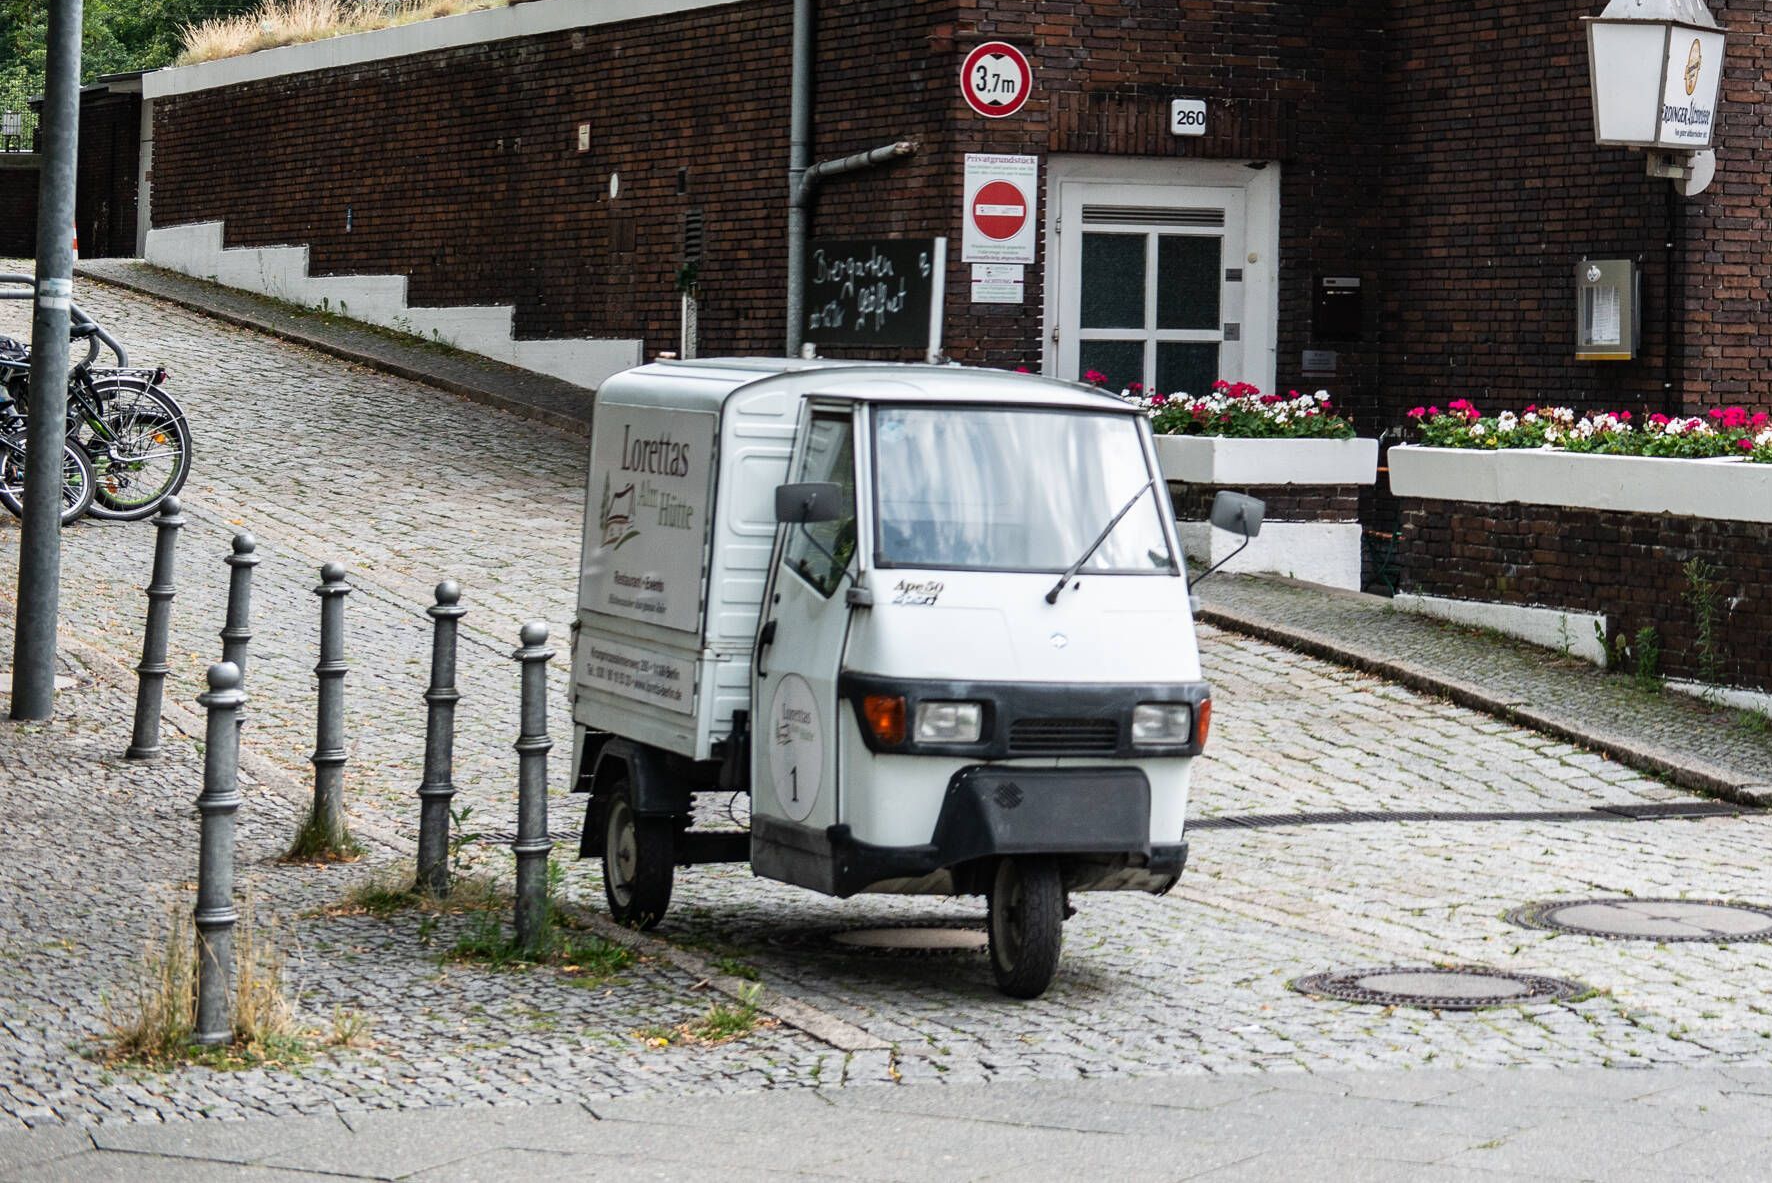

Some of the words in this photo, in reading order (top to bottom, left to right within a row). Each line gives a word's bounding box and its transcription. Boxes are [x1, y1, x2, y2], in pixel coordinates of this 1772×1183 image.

[1176, 110, 1206, 126] 260
[621, 424, 690, 478] Lorettas
[657, 491, 694, 530] Hütte
[790, 765, 799, 803] 1
